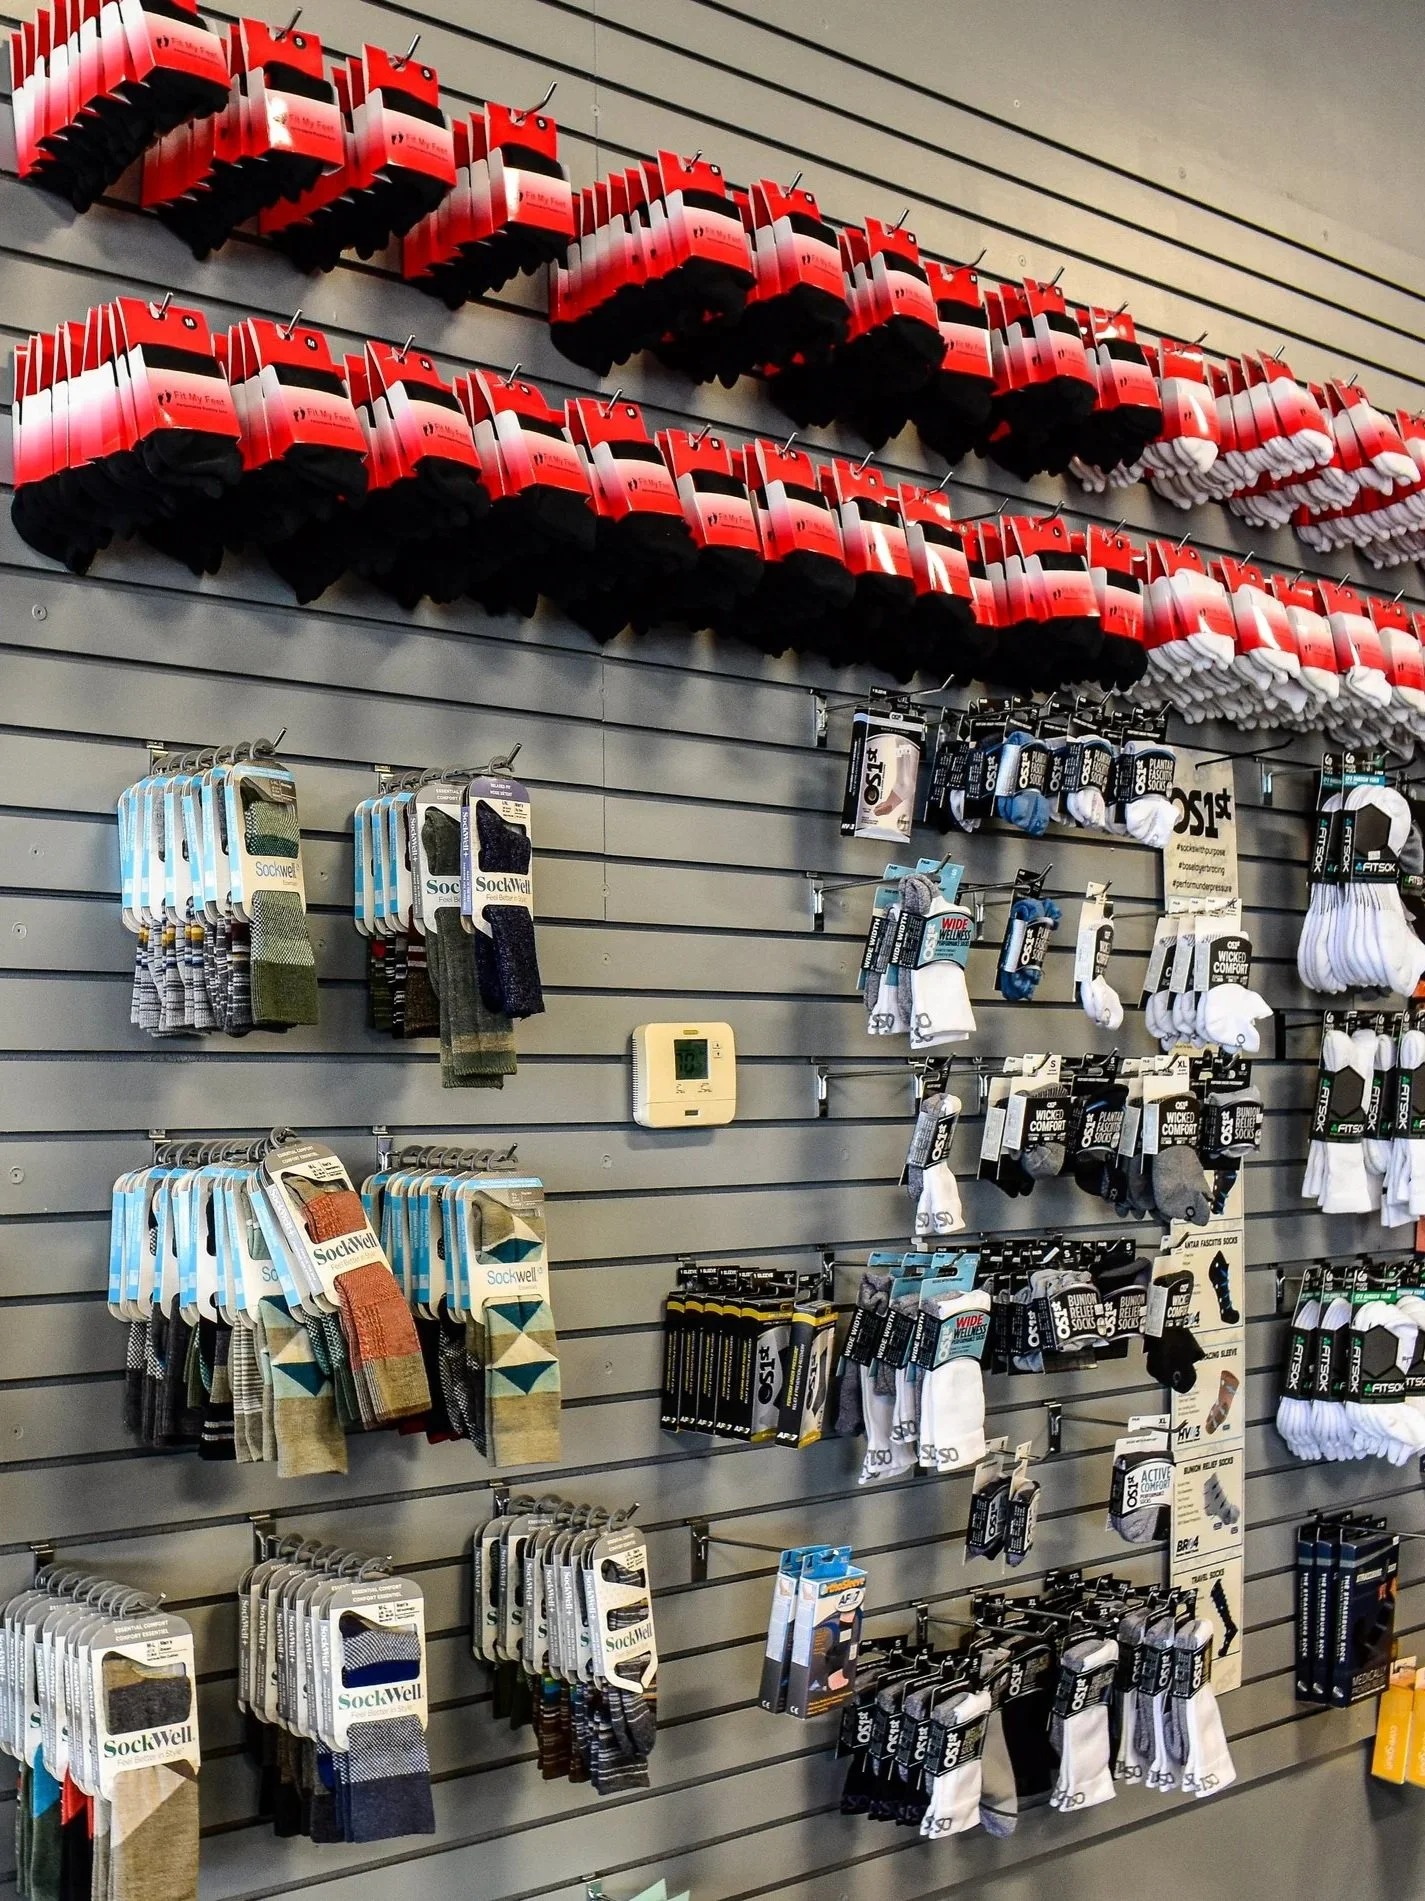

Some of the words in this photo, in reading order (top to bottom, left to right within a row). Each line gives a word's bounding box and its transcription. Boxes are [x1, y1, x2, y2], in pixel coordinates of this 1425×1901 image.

[185, 42, 200, 52] My
[406, 134, 416, 144] Fit
[418, 138, 431, 150] My
[432, 143, 447, 154] Feet
[537, 195, 549, 206] My
[174, 391, 187, 401] Fit
[188, 393, 202, 405] My
[205, 396, 225, 406] Feet
[307, 408, 319, 418] Fit
[320, 410, 333, 421] My
[334, 413, 352, 423] Feet
[1150, 758, 1173, 771] PLANTAR
[1345, 752, 1354, 764] 6
[986, 756, 998, 791] OS1st
[1019, 753, 1031, 788] OS1st
[1081, 750, 1092, 785] OS1st
[863, 748, 884, 805] OS1st
[1135, 760, 1146, 795] OS1st
[1147, 780, 1167, 791] SOCKS
[1177, 843, 1226, 856] #sockswithpurpose
[1314, 827, 1327, 872] FITSOK
[1343, 826, 1352, 872] FITSOK
[256, 861, 296, 878] Sockwell
[1178, 862, 1225, 876] #baselayerbracing
[1363, 863, 1395, 872] FITSOK
[476, 876, 531, 894] SockWell
[1172, 880, 1232, 893] #performunderpressure
[942, 918, 968, 929] WIDE
[891, 940, 901, 964] WIDE
[897, 913, 908, 939] WIDTH
[923, 924, 938, 960] OS1st
[939, 930, 971, 940] WELLNESS
[863, 944, 874, 969] WIDE
[869, 918, 881, 944] WIDTH
[1020, 929, 1033, 965] OS1st
[1218, 950, 1246, 962] WICKED
[1213, 962, 1248, 975] COMFORT
[1326, 1012, 1334, 1023] 6
[1050, 1060, 1056, 1068] S
[1177, 1060, 1187, 1068] XL
[1036, 1109, 1064, 1120] WICKED
[1236, 1107, 1260, 1117] BUNION
[1316, 1086, 1330, 1133] FITSOK
[1367, 1086, 1381, 1130] FITSOK
[1399, 1084, 1410, 1129] FITSOK
[1166, 1112, 1195, 1123] WICKED
[1235, 1118, 1256, 1128] RELIEF
[1029, 1120, 1067, 1132] COMFORT
[1082, 1113, 1095, 1148] OS1st
[1162, 1123, 1197, 1135] COMFORT
[1220, 1111, 1234, 1145] OS1st
[1235, 1128, 1254, 1140] SOCKS
[931, 1123, 947, 1162] OS1st
[1094, 1132, 1112, 1143] SOCKS
[1223, 1236, 1238, 1245] SOCKS
[314, 1233, 378, 1265] SockWell
[1064, 1250, 1071, 1258] S
[488, 1267, 536, 1284] Sockwell
[1357, 1270, 1367, 1282] 6
[1067, 1293, 1097, 1307] BUNION
[1120, 1294, 1146, 1307] BUNION
[1069, 1305, 1096, 1319] RELIEF
[1105, 1302, 1117, 1337] OS1st
[1119, 1305, 1140, 1319] RELIEF
[957, 1314, 984, 1328] WIDE
[1051, 1302, 1070, 1339] OS1st
[1071, 1317, 1096, 1331] SOCKS
[1117, 1317, 1139, 1331] SOCKS
[844, 1337, 856, 1358] WIDE
[850, 1309, 864, 1336] WIDTH
[877, 1338, 888, 1358] WIDE
[883, 1311, 896, 1338] WIDTH
[911, 1341, 920, 1361] WIDE
[916, 1312, 925, 1340] WIDTH
[954, 1324, 987, 1339] WELLNESS
[1027, 1311, 1040, 1347] OS1st
[1220, 1348, 1238, 1359] SLEEVE
[758, 1346, 775, 1404] OS1st
[1289, 1344, 1303, 1390] FITSOK
[1319, 1345, 1330, 1391] FITSOK
[1351, 1346, 1362, 1393] FITSOK
[1141, 1466, 1171, 1482] ACTIVE
[1184, 1464, 1202, 1475] BUNION
[1203, 1460, 1218, 1471] RELIEF
[1219, 1457, 1234, 1466] SOCKS
[1127, 1476, 1139, 1507] OS1st
[1141, 1480, 1170, 1493] COMFORT
[1192, 1574, 1208, 1584] TRAVEL
[1210, 1569, 1225, 1579] SOCKS
[115, 1624, 143, 1633] ESSENTIAL
[144, 1620, 168, 1629] COMFORT
[605, 1623, 653, 1652] SockWell
[973, 1658, 978, 1666] S
[1159, 1655, 1171, 1687] OS1st
[1193, 1655, 1203, 1689] OS1st
[1352, 1665, 1387, 1685] MEDICALLY
[1009, 1663, 1023, 1696] OS1st
[338, 1684, 422, 1710] SockWell
[1072, 1678, 1089, 1711] OS1st
[762, 1700, 770, 1709] CE
[790, 1705, 799, 1714] CE
[857, 1711, 873, 1743] OS1st
[104, 1726, 192, 1758] SockWell
[915, 1726, 929, 1760] OS1st
[943, 1732, 961, 1768] OS1st
